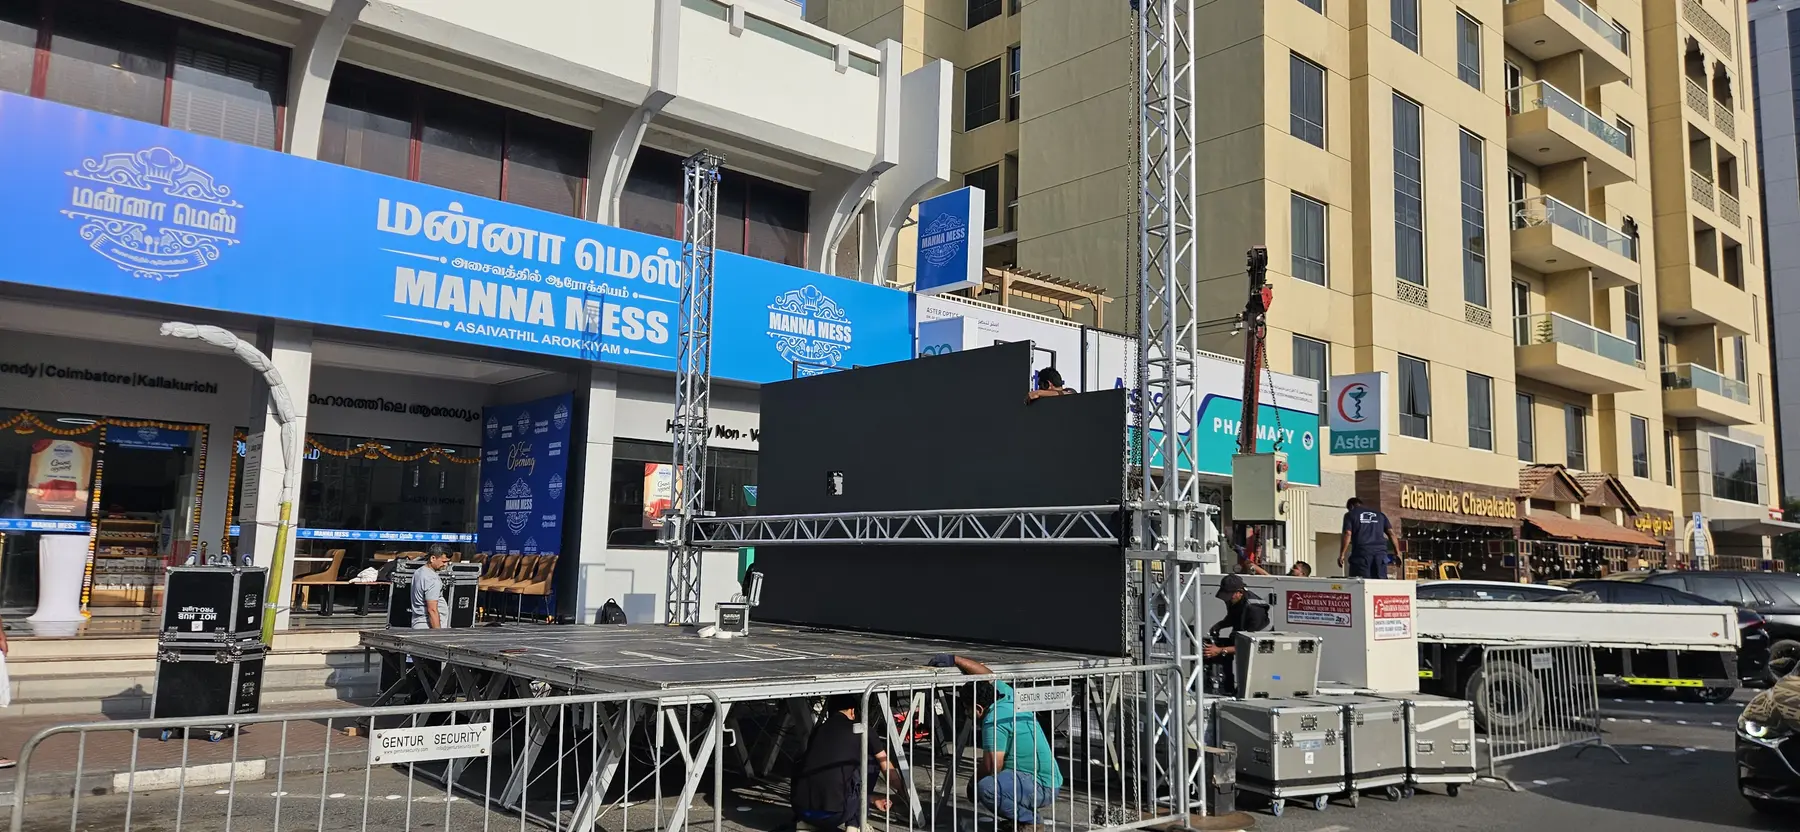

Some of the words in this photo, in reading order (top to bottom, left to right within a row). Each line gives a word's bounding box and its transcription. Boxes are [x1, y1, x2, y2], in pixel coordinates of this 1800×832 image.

[72, 186, 164, 222] மன்னா
[173, 202, 237, 234] மெஸ்
[376, 198, 565, 266] மன்னா
[574, 238, 682, 289] மெஸ்
[921, 232, 945, 249] MANNA
[946, 227, 966, 243] MESS
[451, 256, 542, 283] அசைவத்தில்
[545, 273, 630, 299] ஆரோக்கியம்
[394, 266, 555, 327] MANNA
[565, 297, 669, 344] MESS
[926, 307, 941, 316] ASTER
[454, 320, 538, 343] ASAIVATHIL
[541, 334, 621, 355] AROKKIYAM
[769, 312, 816, 337] MANNA
[818, 321, 852, 343] MESS
[715, 424, 739, 441] Non
[1213, 417, 1294, 444] PHAMACY
[1334, 435, 1377, 449] Aster
[1401, 484, 1459, 514] Adaminde
[1461, 491, 1517, 519] Chayakada
[1020, 692, 1041, 701] GENTUR
[1044, 691, 1066, 700] SECURITY
[382, 735, 424, 748] GENTUR
[434, 731, 482, 745] SECURITY
